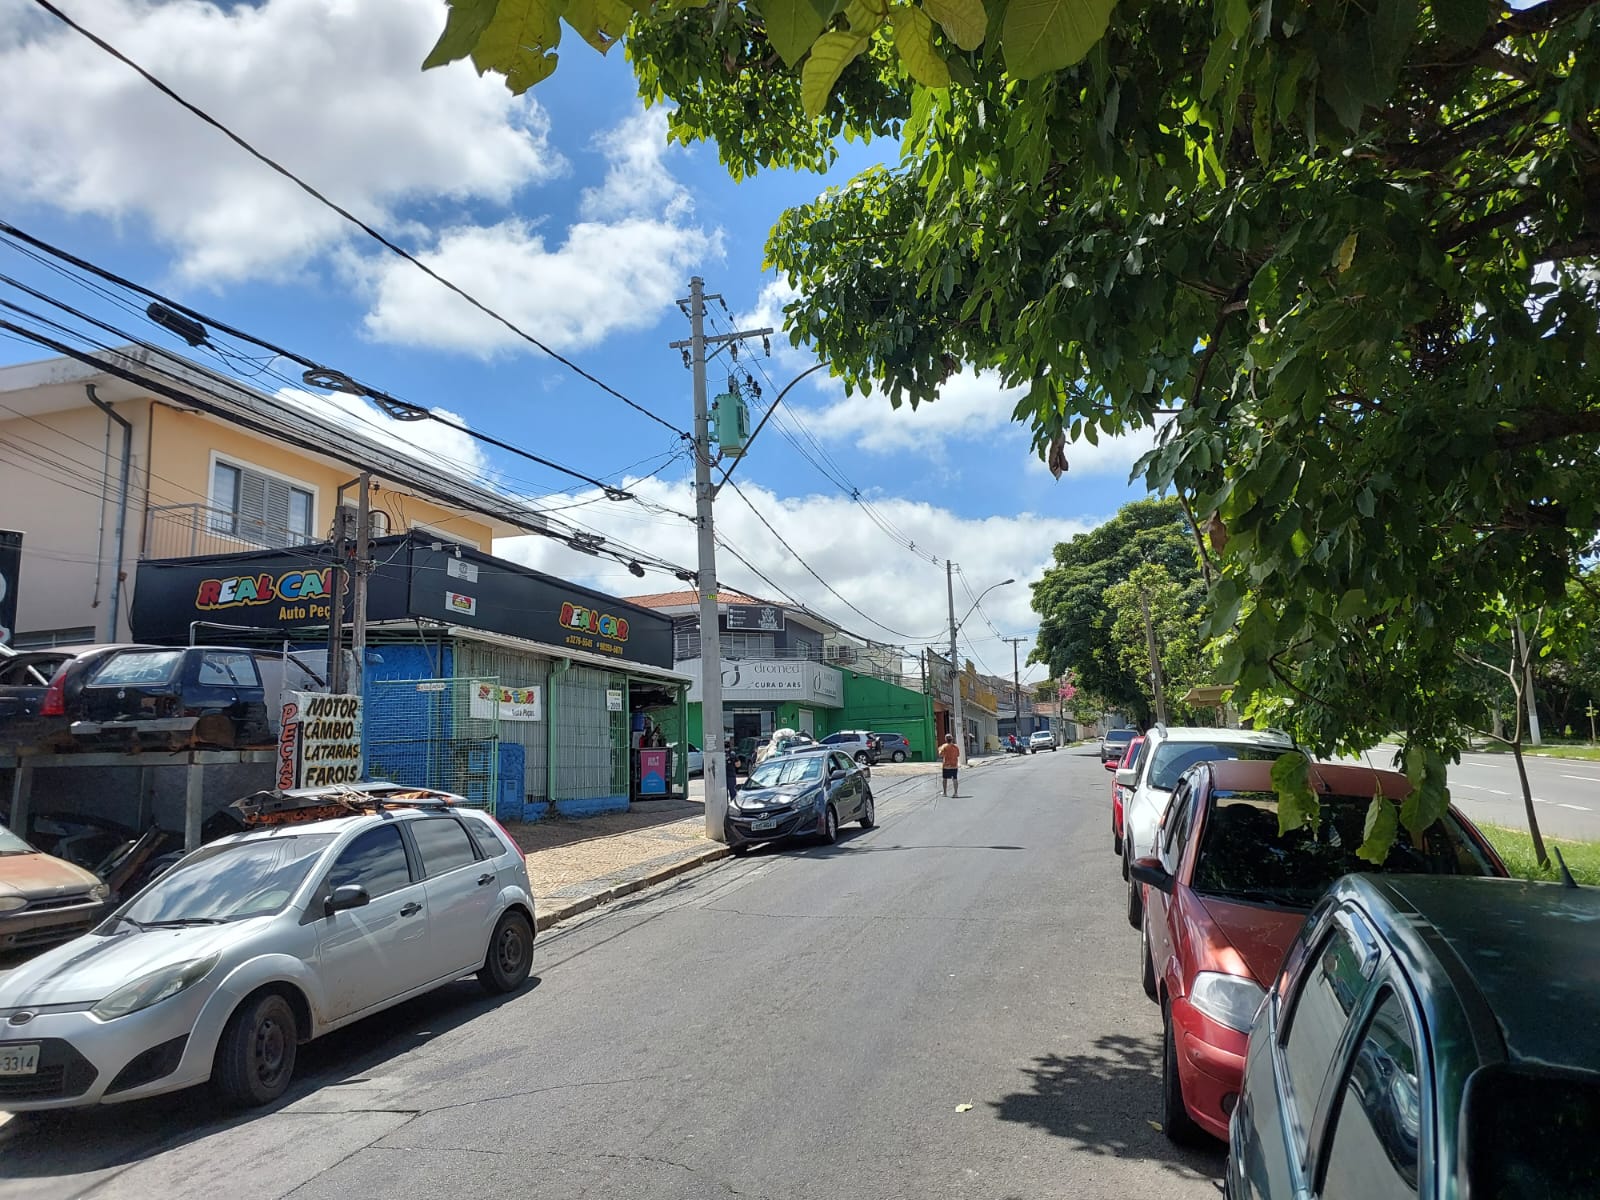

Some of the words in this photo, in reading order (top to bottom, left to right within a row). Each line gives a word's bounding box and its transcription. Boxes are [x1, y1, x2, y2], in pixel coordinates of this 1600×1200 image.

[197, 574, 276, 609] REAL
[279, 606, 305, 620] Auto
[310, 604, 345, 619] Peçs
[559, 602, 599, 634] REAL
[599, 614, 629, 642] CAR
[306, 697, 358, 719] MOTOR
[304, 717, 354, 740] CÂMBIO
[304, 744, 360, 760] LATARIAS
[305, 765, 358, 787] FAROIS
